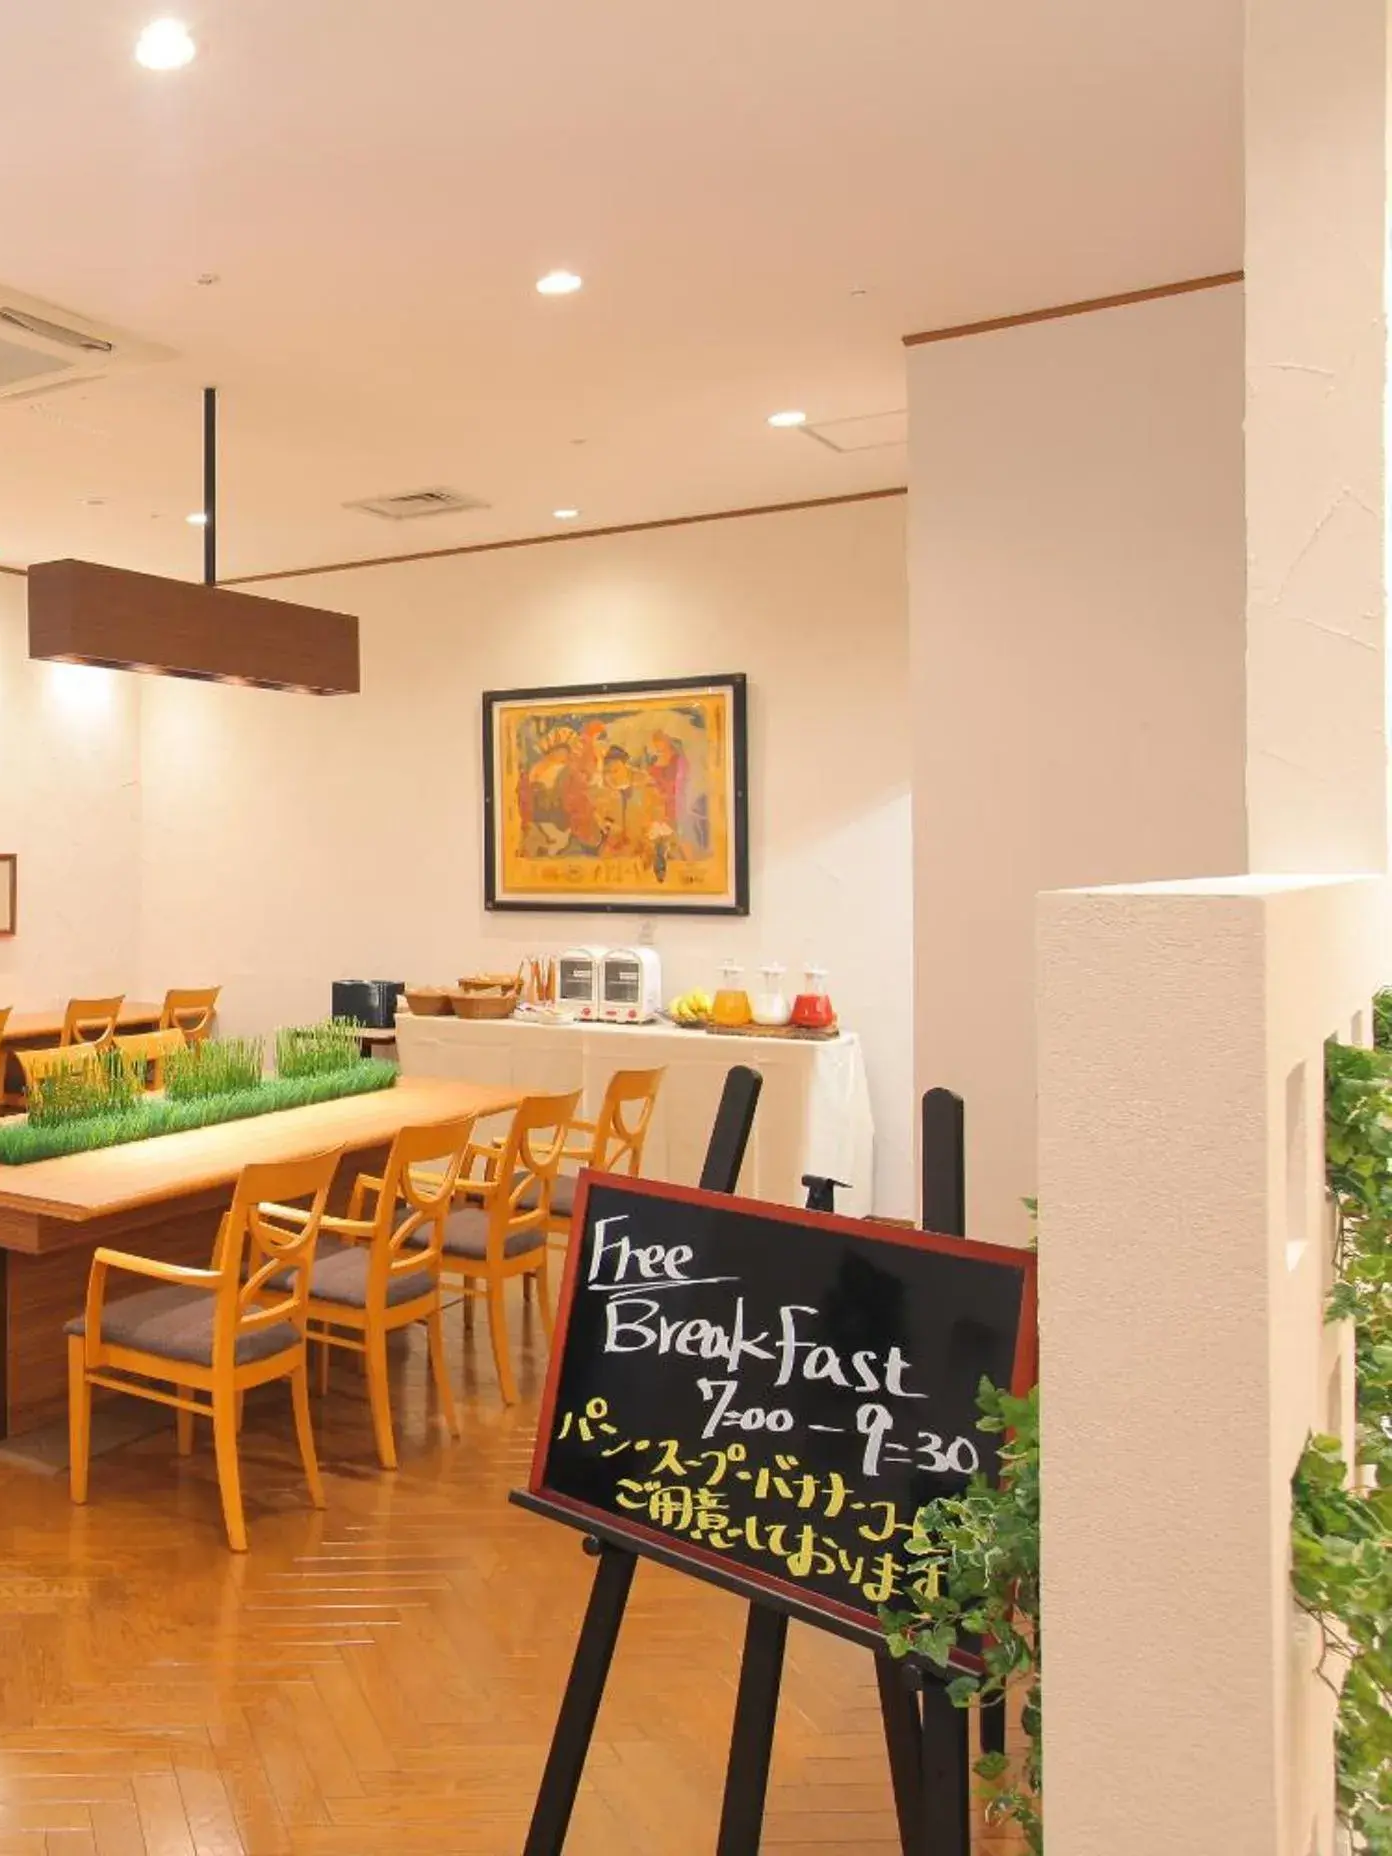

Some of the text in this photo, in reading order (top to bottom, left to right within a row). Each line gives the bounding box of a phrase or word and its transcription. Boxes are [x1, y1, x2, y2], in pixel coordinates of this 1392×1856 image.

[587, 1215, 694, 1280] Free
[615, 1478, 947, 1602] ご用意しております
